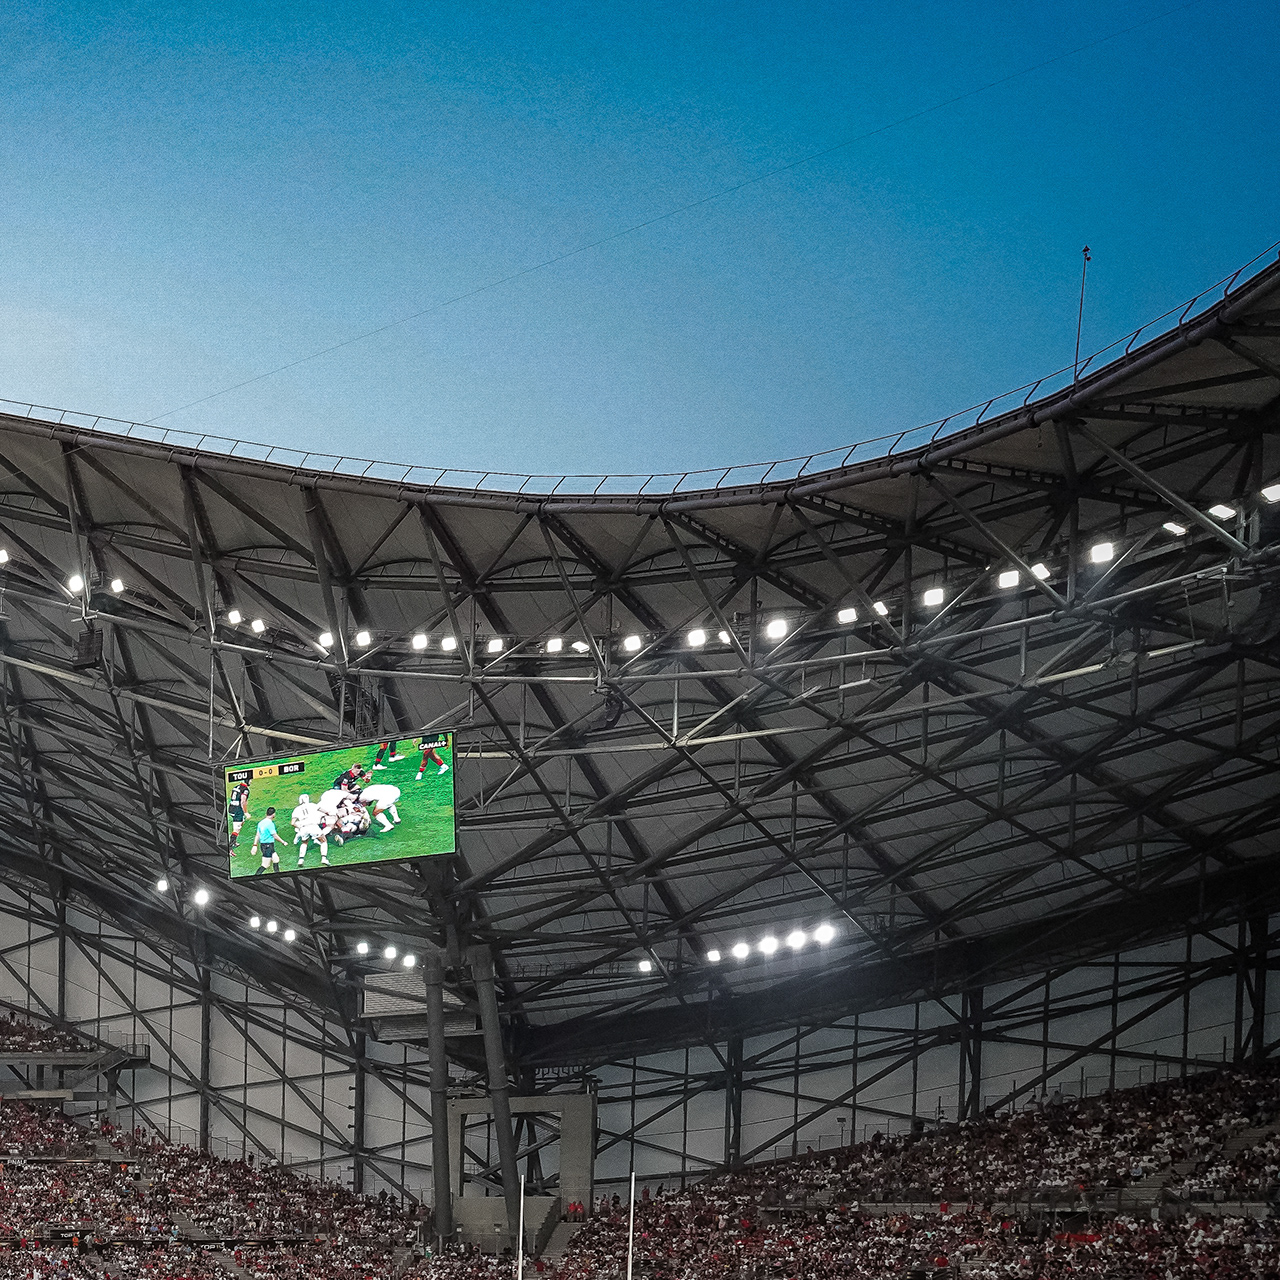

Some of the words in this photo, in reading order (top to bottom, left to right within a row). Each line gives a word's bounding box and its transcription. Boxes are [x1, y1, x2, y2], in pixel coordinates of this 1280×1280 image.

[419, 741, 446, 750] CANAL+
[283, 765, 299, 773] BOR
[232, 772, 248, 780] TOU
